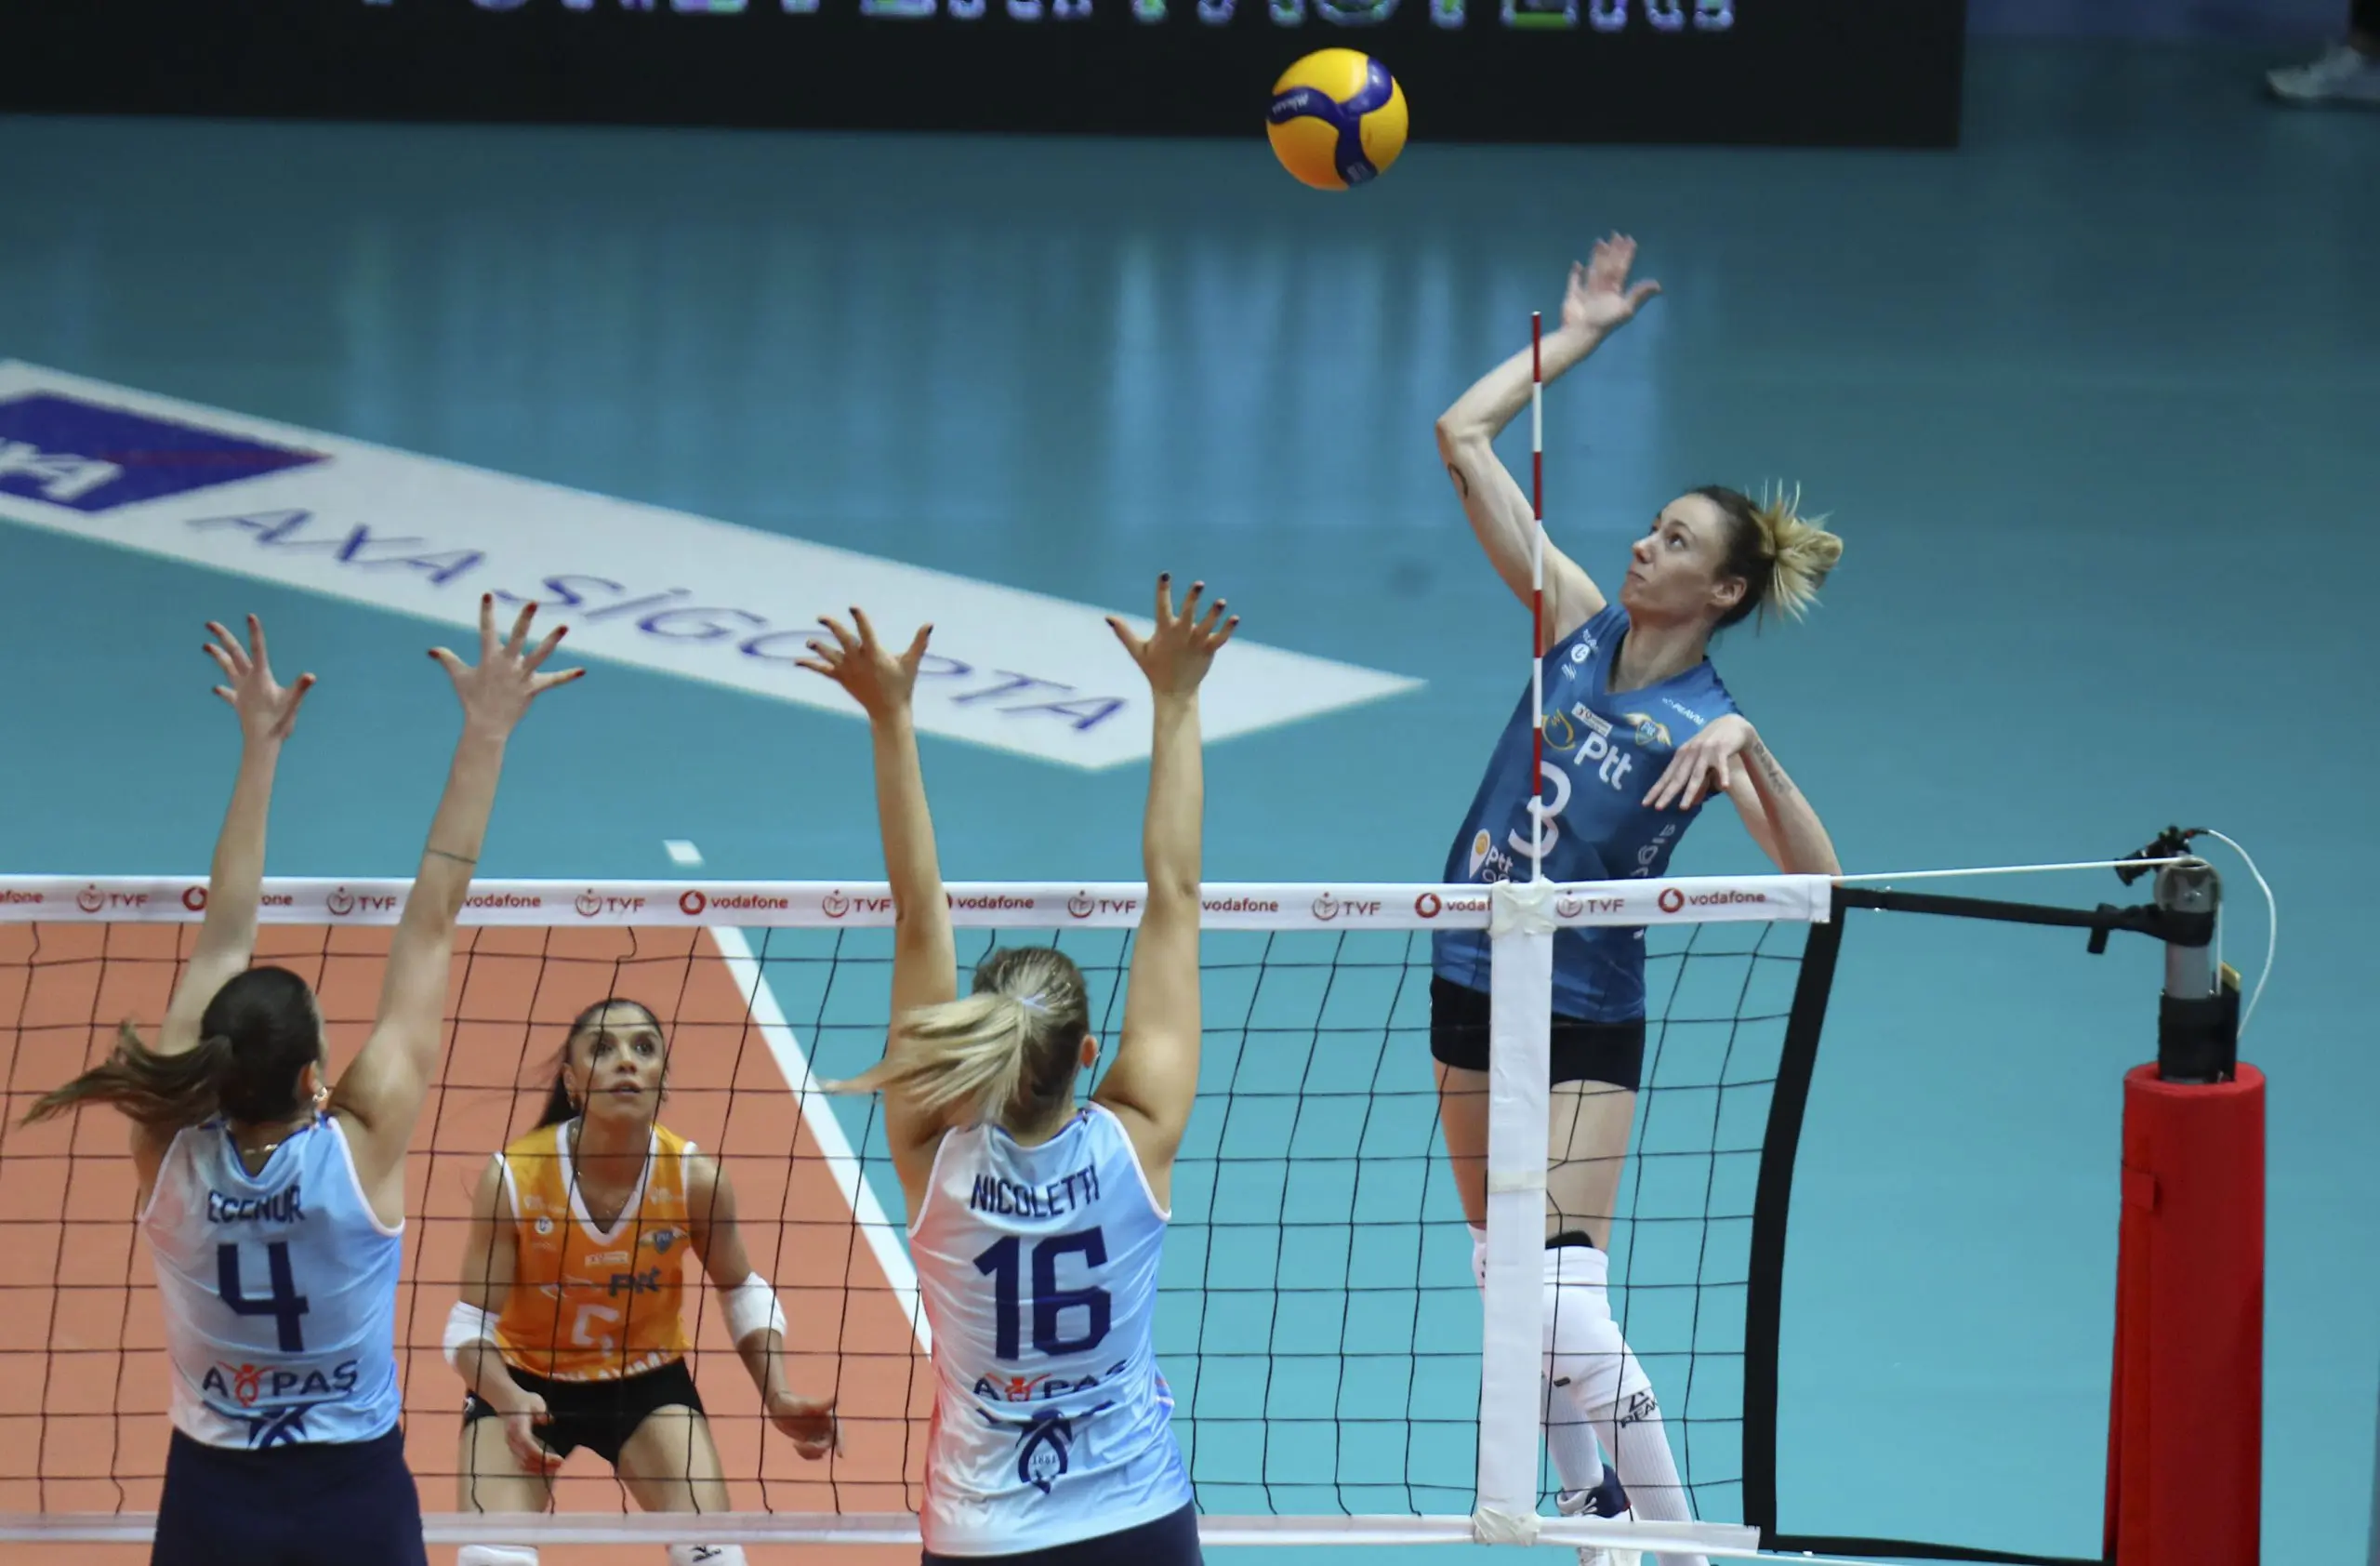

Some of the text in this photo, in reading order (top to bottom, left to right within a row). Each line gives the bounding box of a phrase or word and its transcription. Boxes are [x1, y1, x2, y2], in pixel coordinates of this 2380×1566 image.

[184, 508, 486, 588] AXA
[1573, 731, 1633, 790] Ptt
[1508, 760, 1572, 858] 3
[109, 894, 149, 908] TVF
[358, 896, 396, 910] TVF
[466, 894, 541, 909] vodafone
[607, 897, 645, 912] TVF
[711, 895, 788, 909] vodafone
[853, 898, 891, 912] TVF
[958, 896, 1034, 909] vodafone
[1099, 899, 1136, 913] TVF
[1202, 897, 1278, 912] vodafone
[1343, 901, 1381, 916] TVF
[1587, 892, 1765, 913] TVF vodafone
[970, 1163, 1102, 1219] NICOLETTI
[217, 1241, 309, 1352] 4
[972, 1226, 1112, 1360] 16
